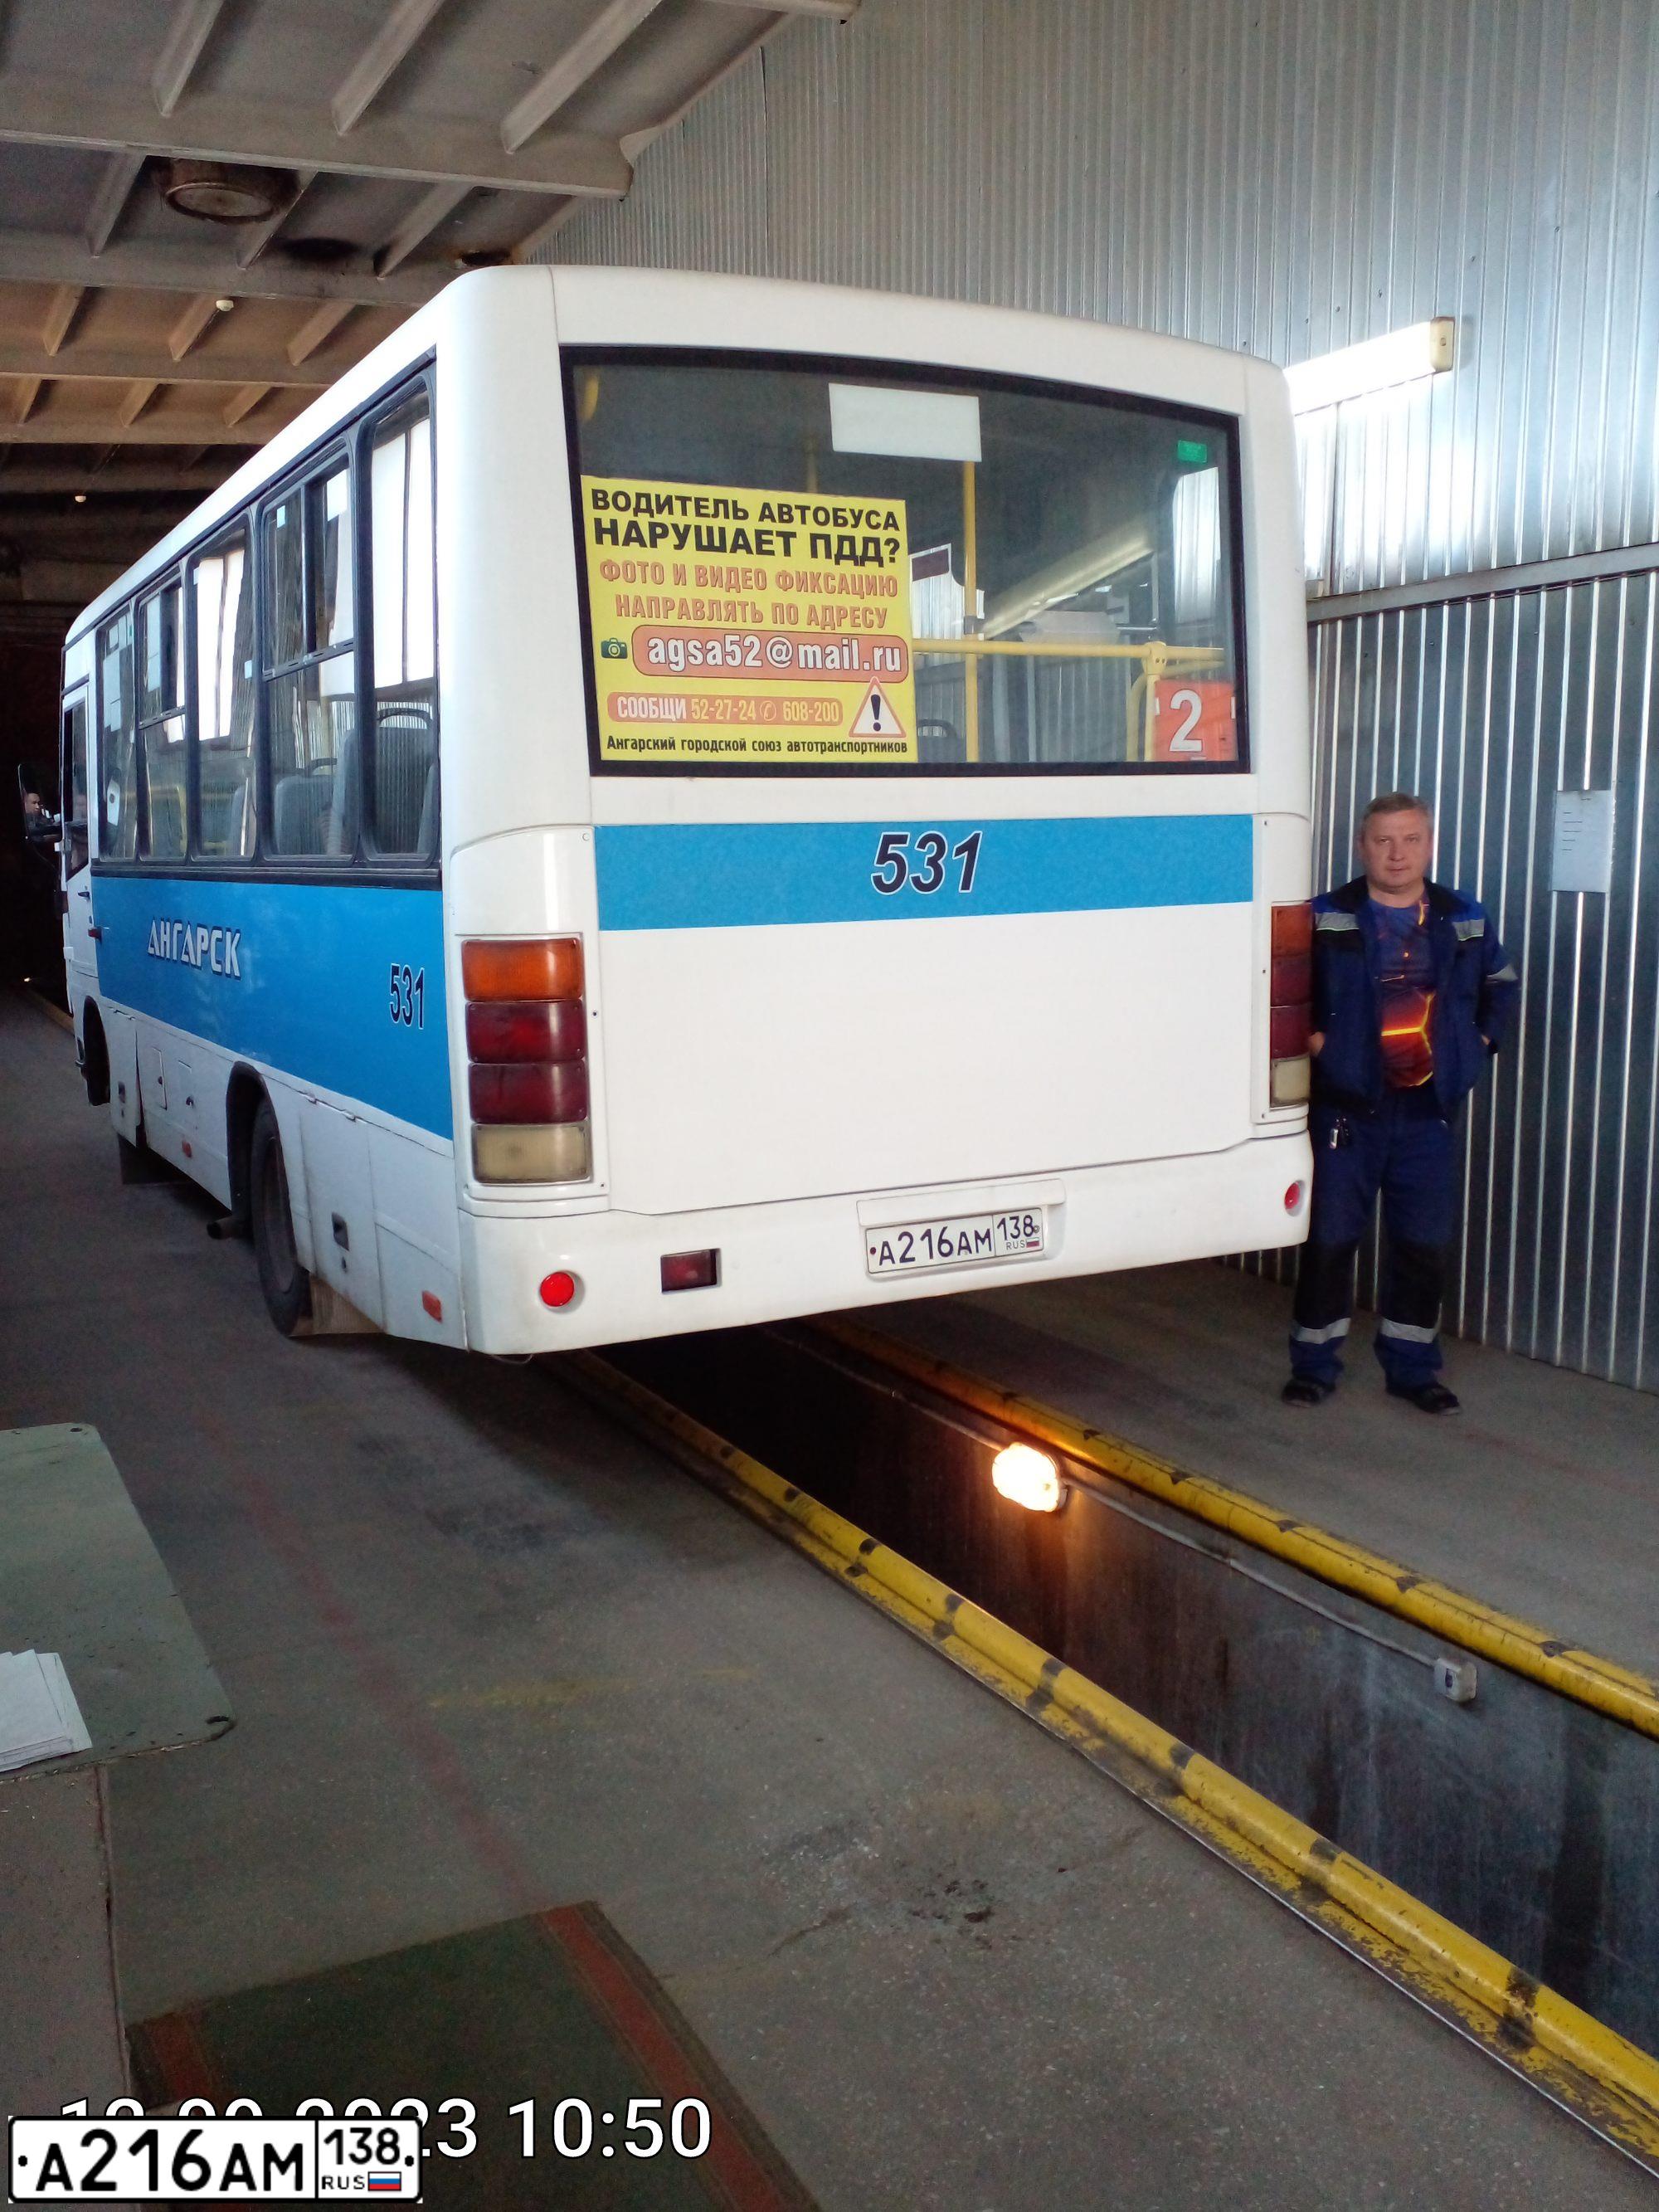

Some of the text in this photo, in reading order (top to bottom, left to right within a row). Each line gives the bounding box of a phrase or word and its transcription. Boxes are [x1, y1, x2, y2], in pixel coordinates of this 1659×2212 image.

[591, 489, 900, 531] ВОДИТЕЛЬ АВТОБУСА
[594, 518, 900, 568] НАРУШАЕТ ПДД?
[600, 559, 898, 599] ФОТО И ВИДЕО ФИКСАЦИЮ
[615, 594, 888, 631] НАПРАВЛЯТЬ ПО АДРЕСУ
[647, 634, 902, 673] agsa52@mail.ru
[617, 696, 839, 722] СООБЩИ 52-27-24 608-200
[1169, 689, 1203, 752] 2
[607, 735, 907, 754] Ангарский городской союз автотранспортников
[871, 831, 982, 895] 531
[148, 917, 241, 981] АНГАРСК
[390, 962, 425, 1030] 531
[879, 1215, 1034, 1265] А216АМ 138
[1006, 1240, 1025, 1250] RUS
